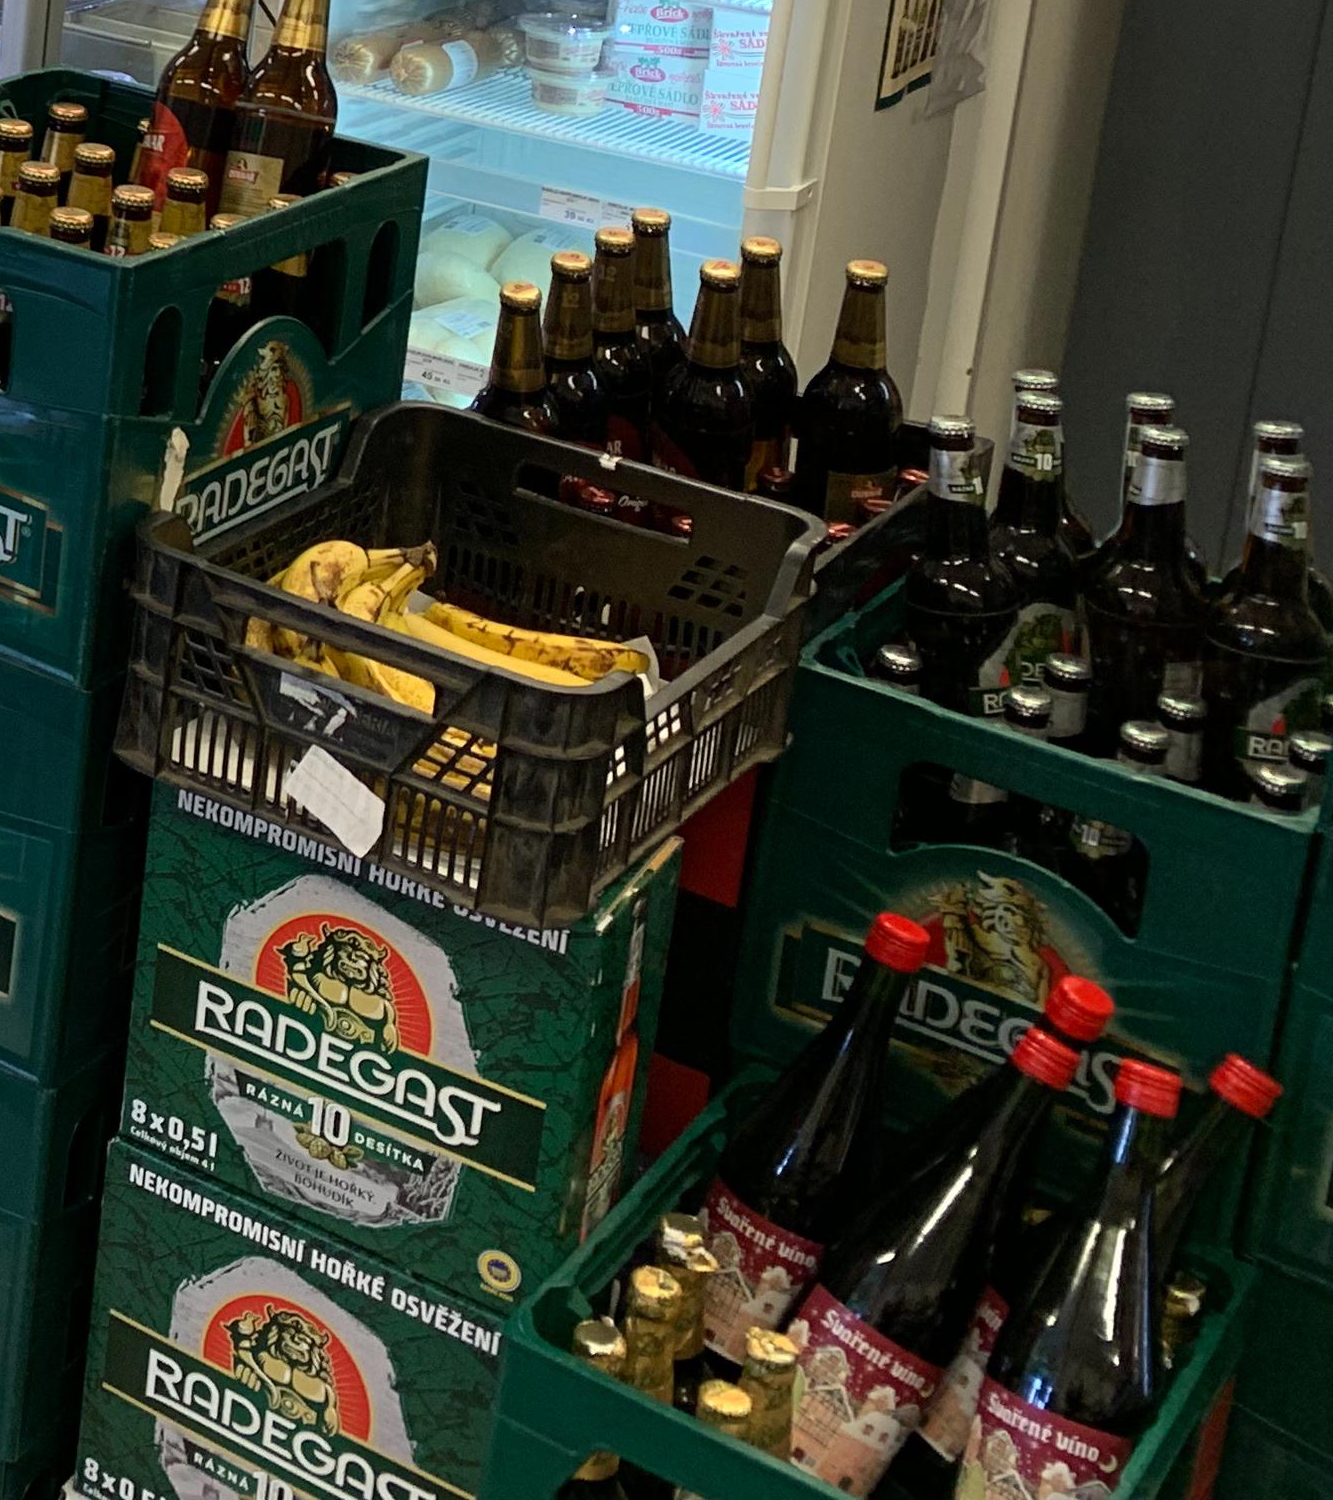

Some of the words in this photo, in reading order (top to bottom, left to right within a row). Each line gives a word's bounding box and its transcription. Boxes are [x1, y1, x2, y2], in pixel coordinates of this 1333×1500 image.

[1035, 453, 1053, 471] 10
[195, 979, 502, 1149] RADEGAST
[245, 1081, 305, 1119] RÁZNÁ
[307, 1094, 352, 1148] 10
[353, 1131, 425, 1173] DESÍTKA
[129, 1163, 307, 1263] NEKOMPROMISNÍ
[310, 1247, 386, 1301] HOŘKÉ
[389, 1286, 503, 1358] OSVĚŽENÍ
[715, 1195, 777, 1255] Svařené
[820, 1307, 890, 1372] Svařené
[891, 1358, 926, 1391] víno
[985, 1391, 1053, 1446] Svařené
[1055, 1430, 1101, 1464] víno
